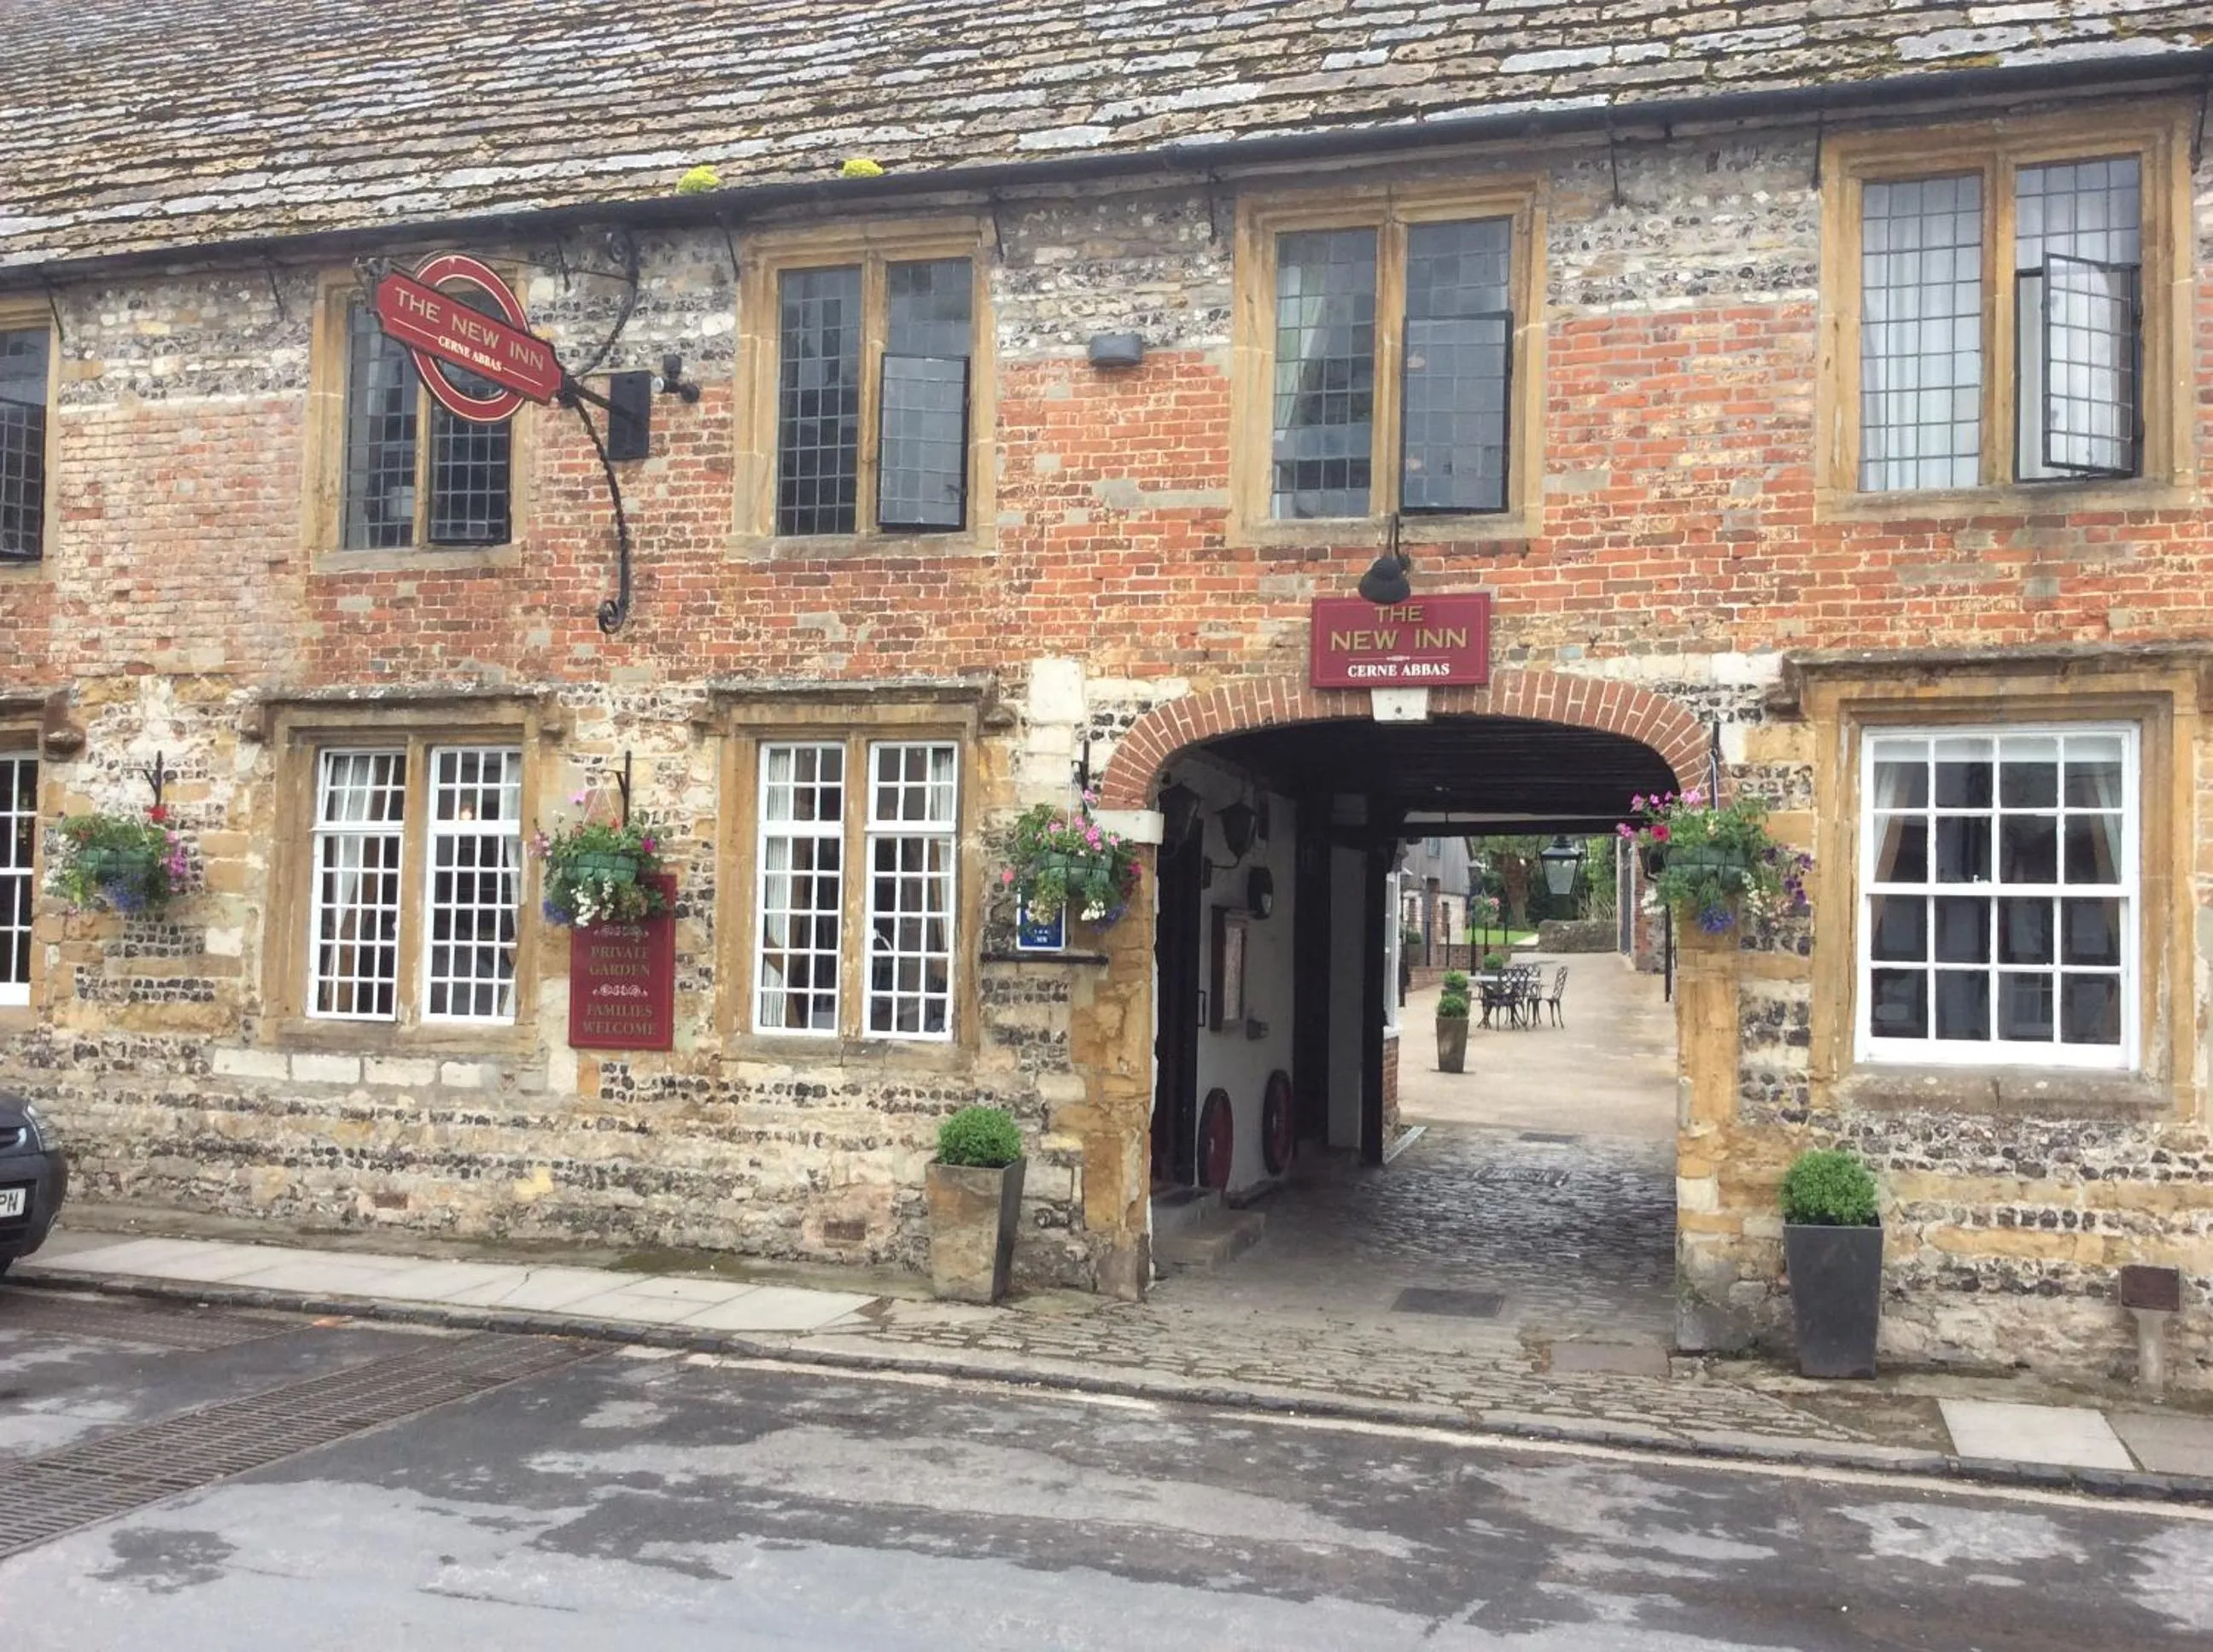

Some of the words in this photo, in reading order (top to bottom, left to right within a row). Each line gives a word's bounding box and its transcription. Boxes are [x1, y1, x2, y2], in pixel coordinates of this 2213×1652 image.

[395, 287, 441, 324] THE
[451, 313, 499, 349] NEW
[510, 341, 544, 371] INN
[437, 336, 470, 359] CERNE
[472, 350, 503, 371] ABBAS
[1375, 604, 1424, 623] THE
[1330, 628, 1398, 651] NEW
[1414, 627, 1468, 649] INN
[1347, 664, 1398, 678] CERNE
[1401, 663, 1450, 676] ABBAS
[591, 946, 650, 960] PRIVATE
[589, 963, 651, 978] GARDEN
[587, 1003, 653, 1018] FAMILIES
[582, 1022, 656, 1036] WELCOME
